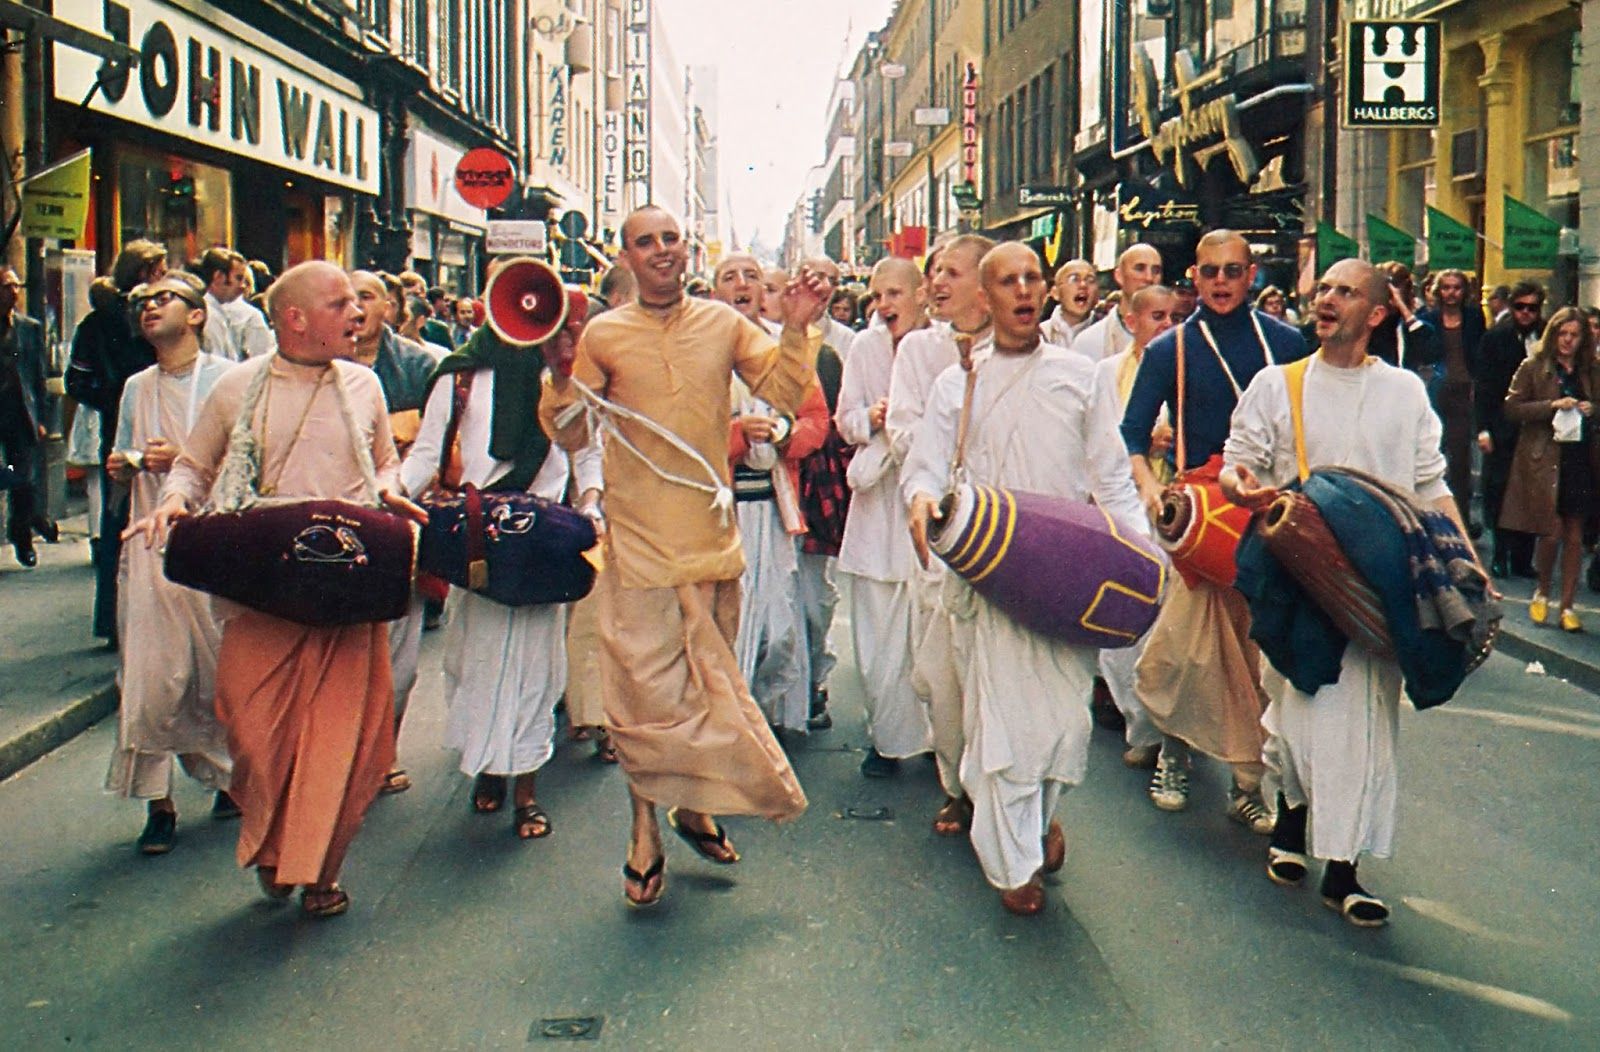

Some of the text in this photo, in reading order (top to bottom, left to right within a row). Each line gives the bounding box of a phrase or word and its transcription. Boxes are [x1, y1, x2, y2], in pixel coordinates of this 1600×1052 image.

[97, 0, 368, 181] JOHN WALL
[1354, 107, 1436, 120] HALLBERGS
[604, 113, 618, 213] HOTEL
